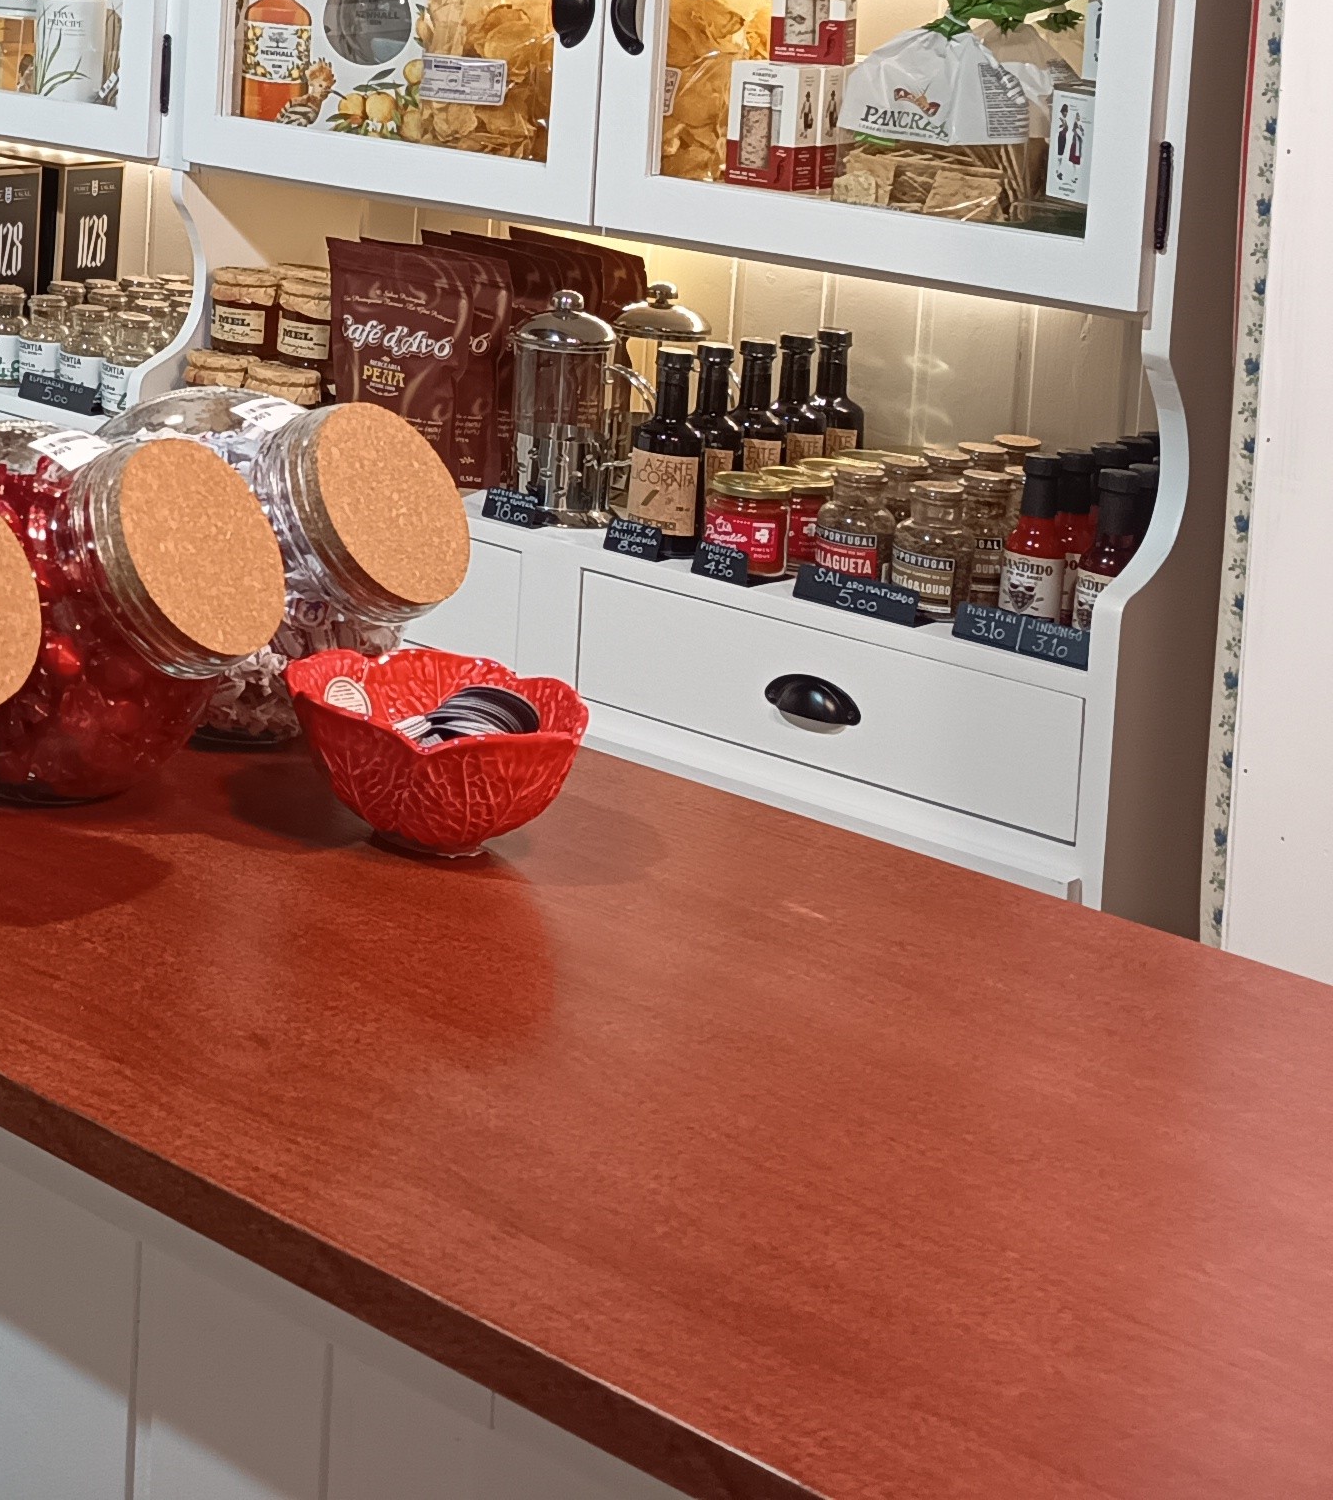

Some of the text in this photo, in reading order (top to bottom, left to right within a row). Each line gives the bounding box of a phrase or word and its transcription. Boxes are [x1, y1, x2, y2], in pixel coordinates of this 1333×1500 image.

[260, 49, 294, 58] NEWHALL
[77, 214, 107, 268] 1128
[218, 315, 250, 326] MEL
[283, 328, 313, 341] MEL
[343, 315, 454, 358] Café d'Avó
[362, 365, 405, 387] PENA
[41, 387, 68, 404] 5.00
[644, 457, 694, 475] AZEITE
[493, 501, 528, 523] 18.00
[612, 519, 644, 533] AZEITE
[617, 540, 643, 554] 8.00
[824, 530, 874, 547] PORTUGAL
[708, 553, 731, 565] DOCE
[816, 549, 872, 574] ALAGUETA
[899, 553, 952, 571] PORTUGAL
[704, 563, 734, 578] 4.50
[814, 568, 915, 605] SAL AROMATIZADO
[835, 589, 878, 612] 5.00
[966, 605, 1016, 624] PIRI-PIRI
[971, 618, 1005, 640] 3.10
[1027, 619, 1083, 642] JINDUNGO
[1032, 634, 1068, 658] 3.10
